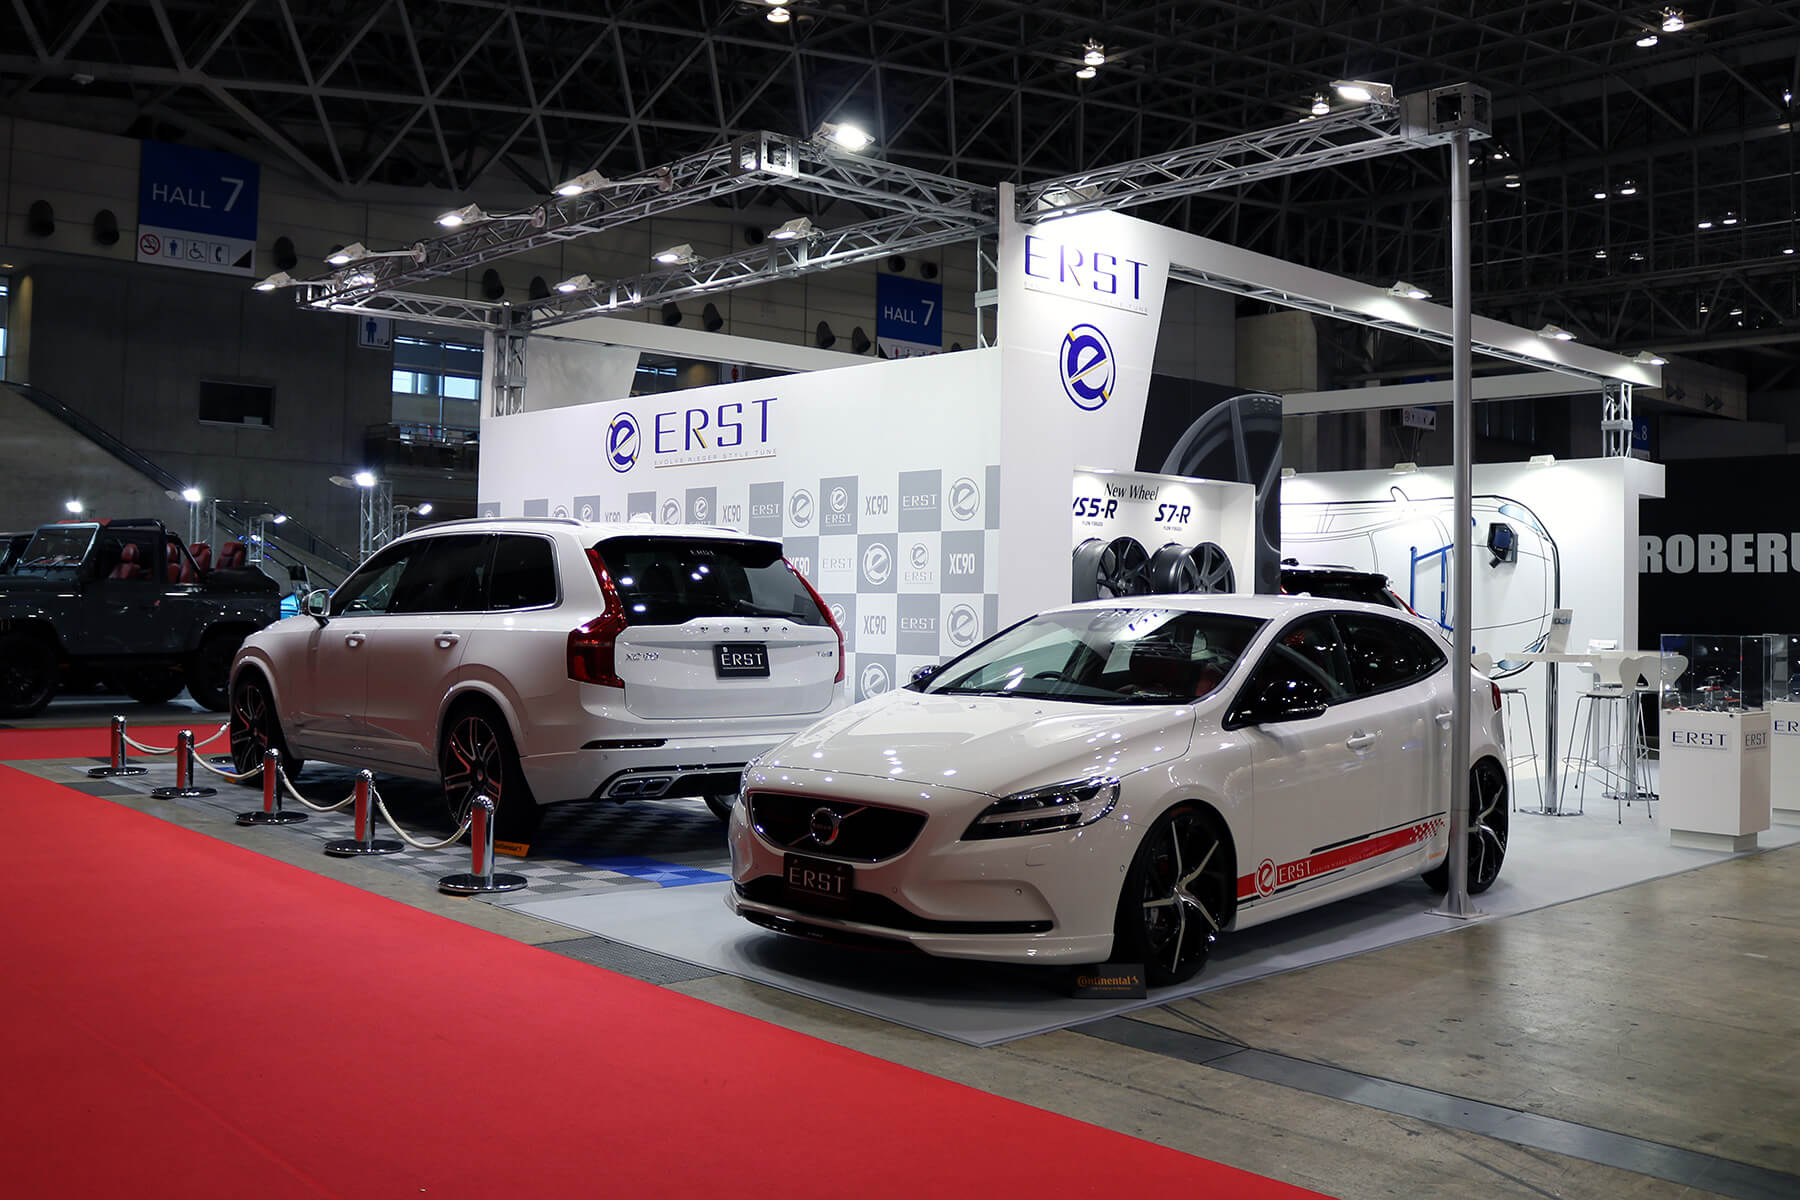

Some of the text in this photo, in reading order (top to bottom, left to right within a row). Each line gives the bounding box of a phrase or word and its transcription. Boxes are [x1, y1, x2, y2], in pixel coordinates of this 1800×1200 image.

[152, 175, 245, 212] HALL 7
[1025, 234, 1149, 300] ERST
[884, 299, 935, 326] HALL 7
[655, 397, 778, 454] ERST
[1641, 424, 1648, 441] 8
[903, 494, 937, 507] ERST
[1104, 482, 1160, 501] New Wheel
[722, 505, 742, 522] XC90
[751, 503, 780, 516] ERST
[865, 495, 889, 516] XC90
[1154, 503, 1191, 523] S7-R
[825, 512, 852, 524] ERST
[822, 558, 853, 569] ERST
[948, 553, 976, 574] XC90
[904, 571, 934, 582] ERST
[863, 615, 887, 635] XC90
[901, 617, 937, 630] ERST
[721, 652, 764, 666] ERST
[1672, 730, 1728, 746] ERST
[1745, 731, 1767, 746] ERST
[789, 866, 846, 893] ERST
[1279, 860, 1312, 883] ERST
